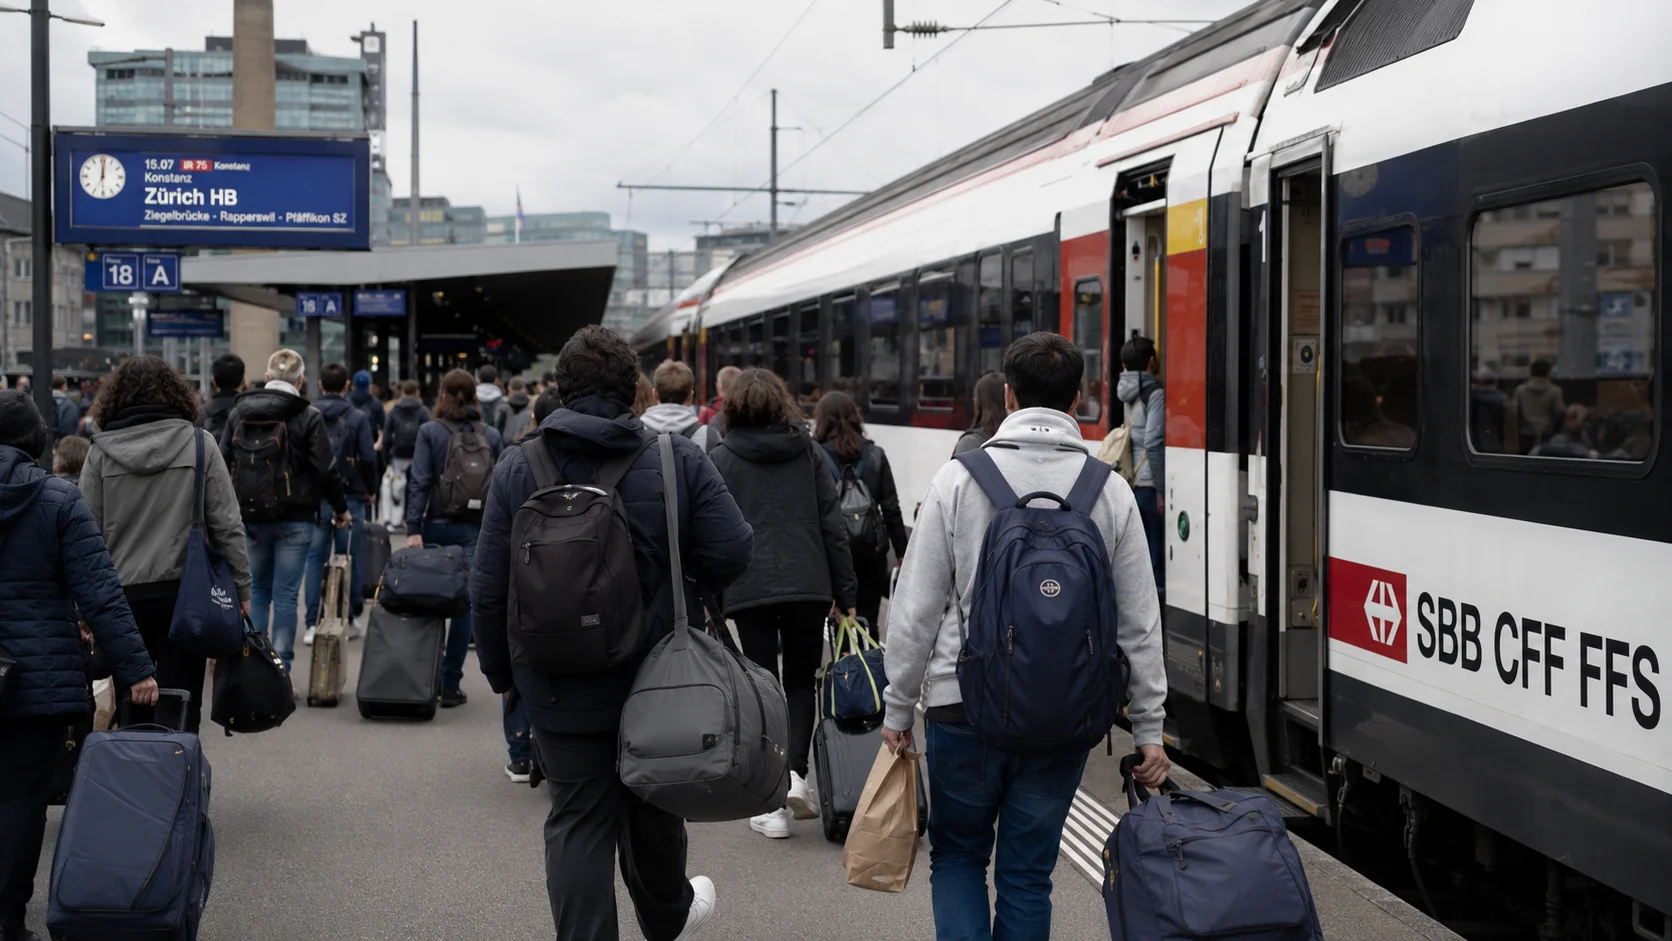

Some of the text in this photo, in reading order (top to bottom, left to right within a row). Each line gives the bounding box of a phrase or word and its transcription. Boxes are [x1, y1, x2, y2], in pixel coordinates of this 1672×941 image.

[144, 159, 175, 170] 15.07
[196, 160, 208, 170] 75
[214, 161, 251, 171] Konstanz
[144, 172, 192, 183] Konstanz
[144, 187, 238, 206] Zürich HB
[144, 209, 210, 223] Ziegelbrücke
[220, 210, 276, 224] Rapperswil
[332, 212, 348, 224] SZ
[1258, 210, 1266, 263] 1
[109, 264, 170, 285] 18 A
[325, 299, 337, 313] A
[1416, 591, 1662, 730] SBB CFF FFS
